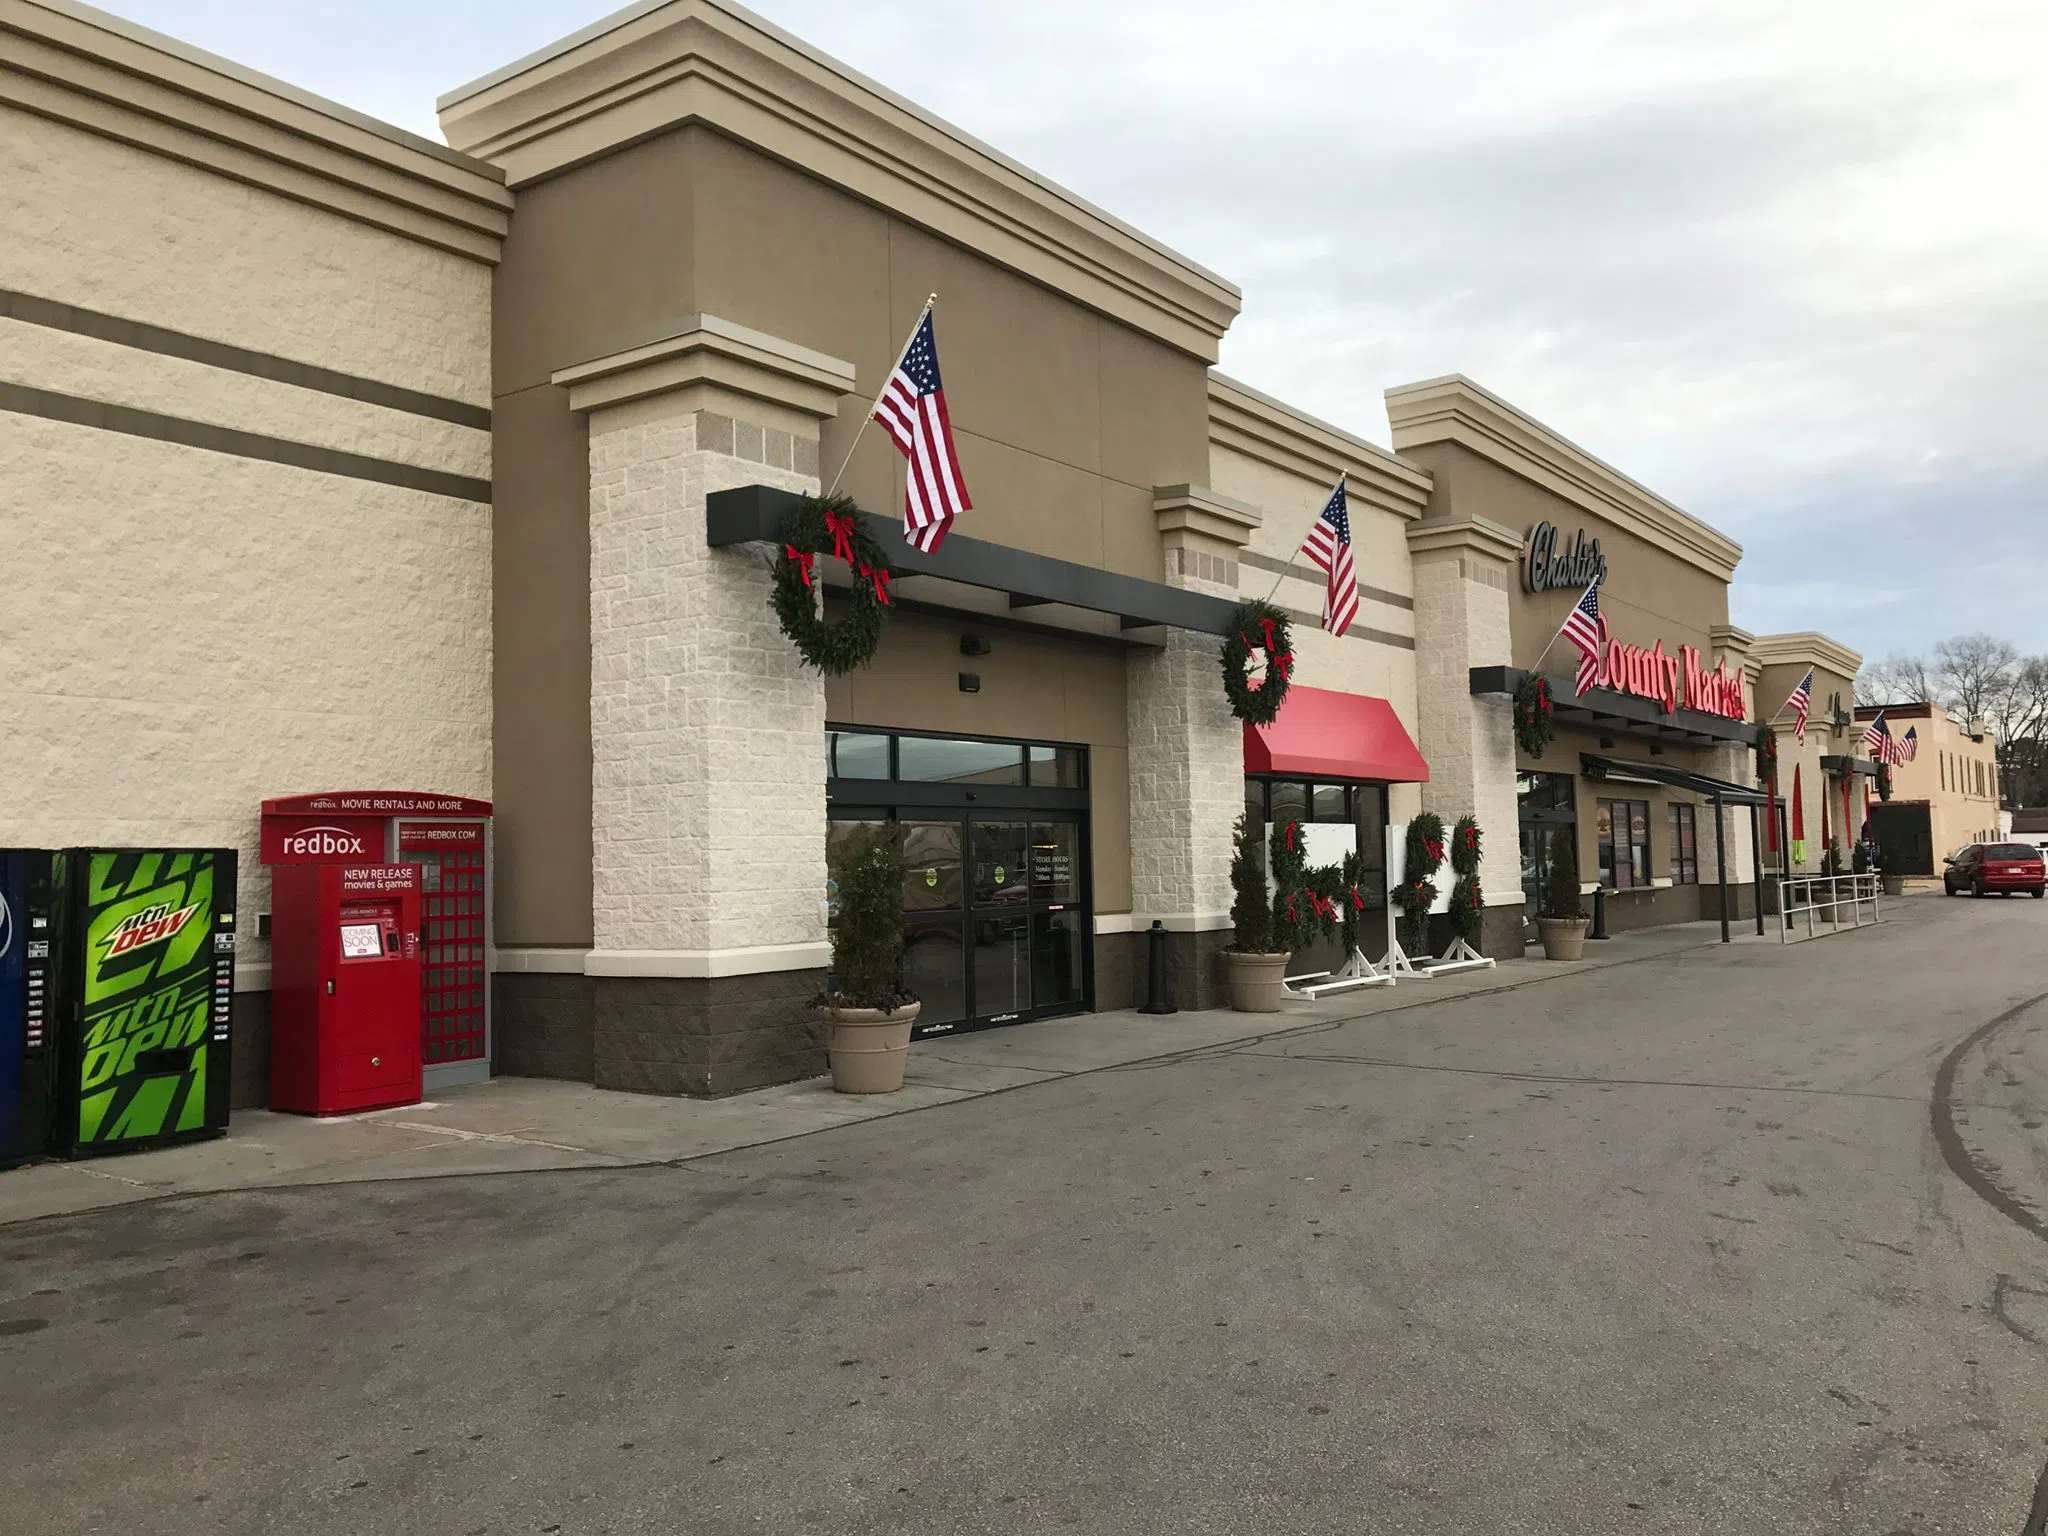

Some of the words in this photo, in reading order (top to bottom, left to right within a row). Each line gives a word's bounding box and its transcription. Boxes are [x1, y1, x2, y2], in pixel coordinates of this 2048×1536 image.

[1525, 521, 1608, 594] Charlie's
[1680, 645, 1748, 720] Market
[310, 799, 337, 809] redbox
[341, 799, 371, 809] MOVIE
[373, 799, 415, 810] RENTALS
[416, 800, 435, 810] AND
[437, 800, 463, 811] MORE
[283, 833, 363, 855] redbox
[344, 869, 369, 880] NEW
[371, 868, 412, 879] RELEASE
[344, 879, 376, 890] movies
[377, 879, 384, 889] &
[385, 879, 412, 891] games
[342, 927, 376, 937] COMING
[344, 936, 378, 948] SOON
